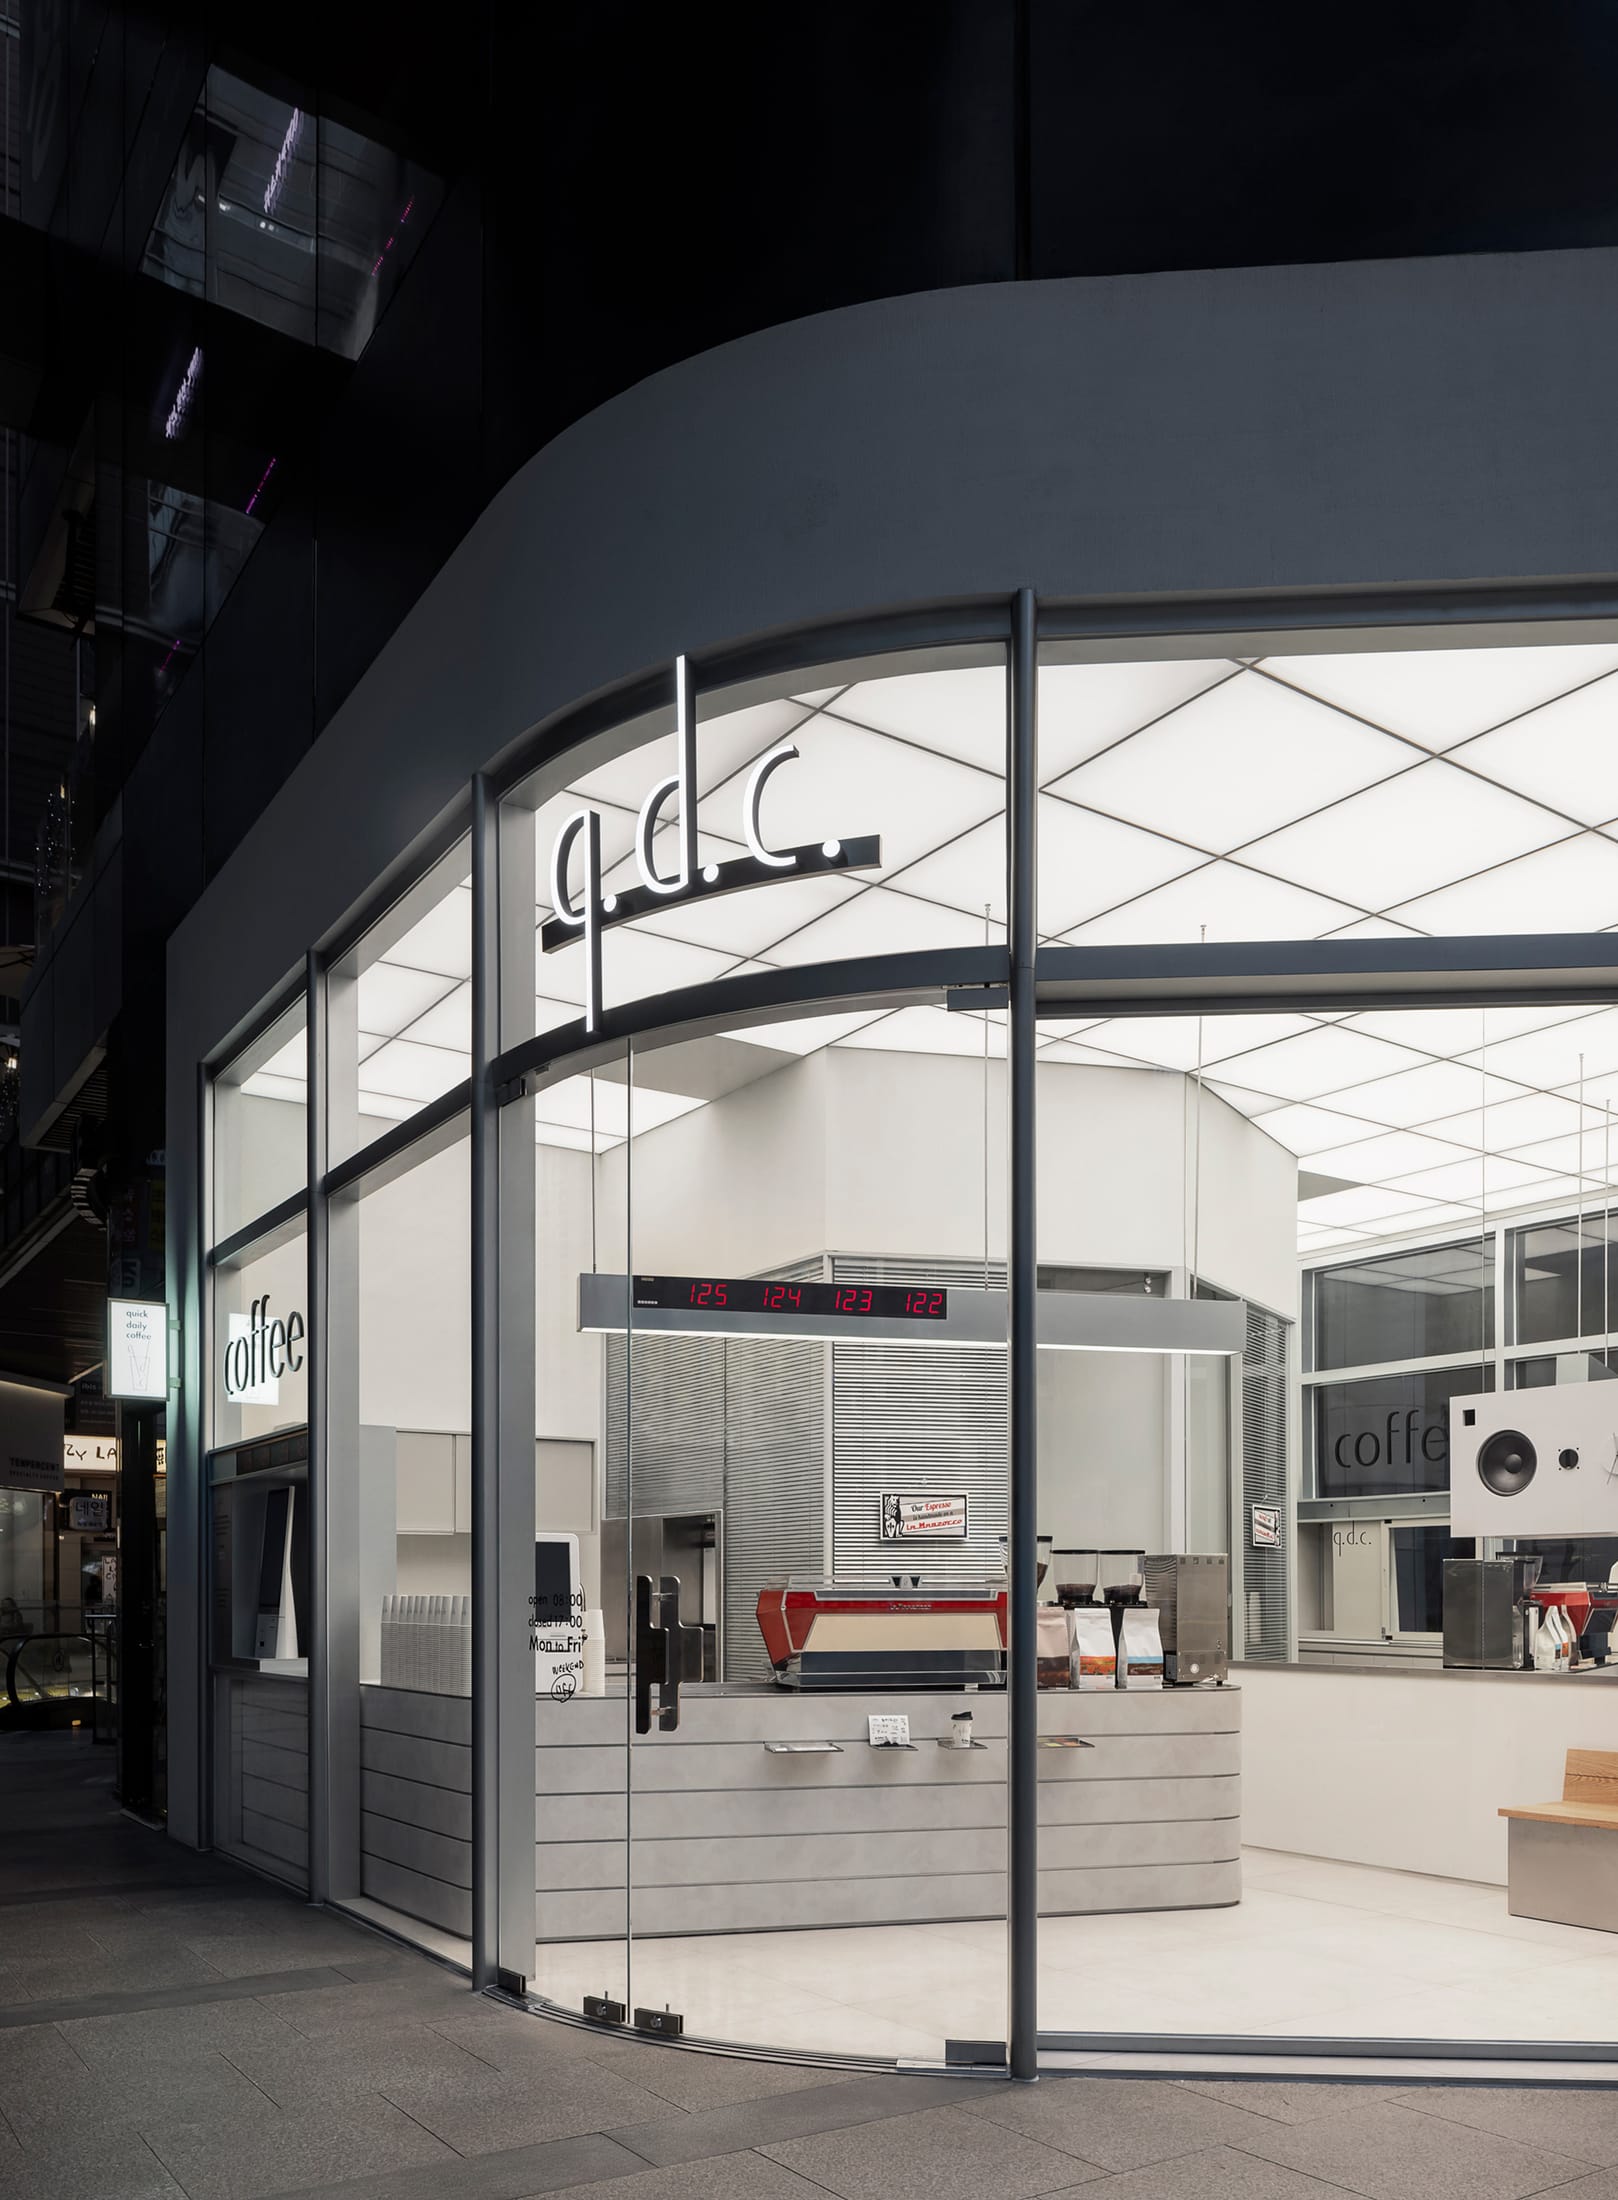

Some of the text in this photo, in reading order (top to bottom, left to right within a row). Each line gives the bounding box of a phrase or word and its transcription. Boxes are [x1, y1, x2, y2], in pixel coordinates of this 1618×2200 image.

[550, 654, 841, 1032] q.d.c.
[690, 1283, 943, 1315] 125 124 123 122
[126, 1310, 149, 1318] quick
[126, 1320, 147, 1331] daily
[126, 1331, 152, 1340] coffee
[223, 1294, 305, 1395] coffee
[1333, 1520, 1372, 1557] q.d.c.
[528, 1596, 548, 1608] open
[528, 1613, 583, 1628] closed 17:00
[529, 1635, 582, 1653] Mon to Fri
